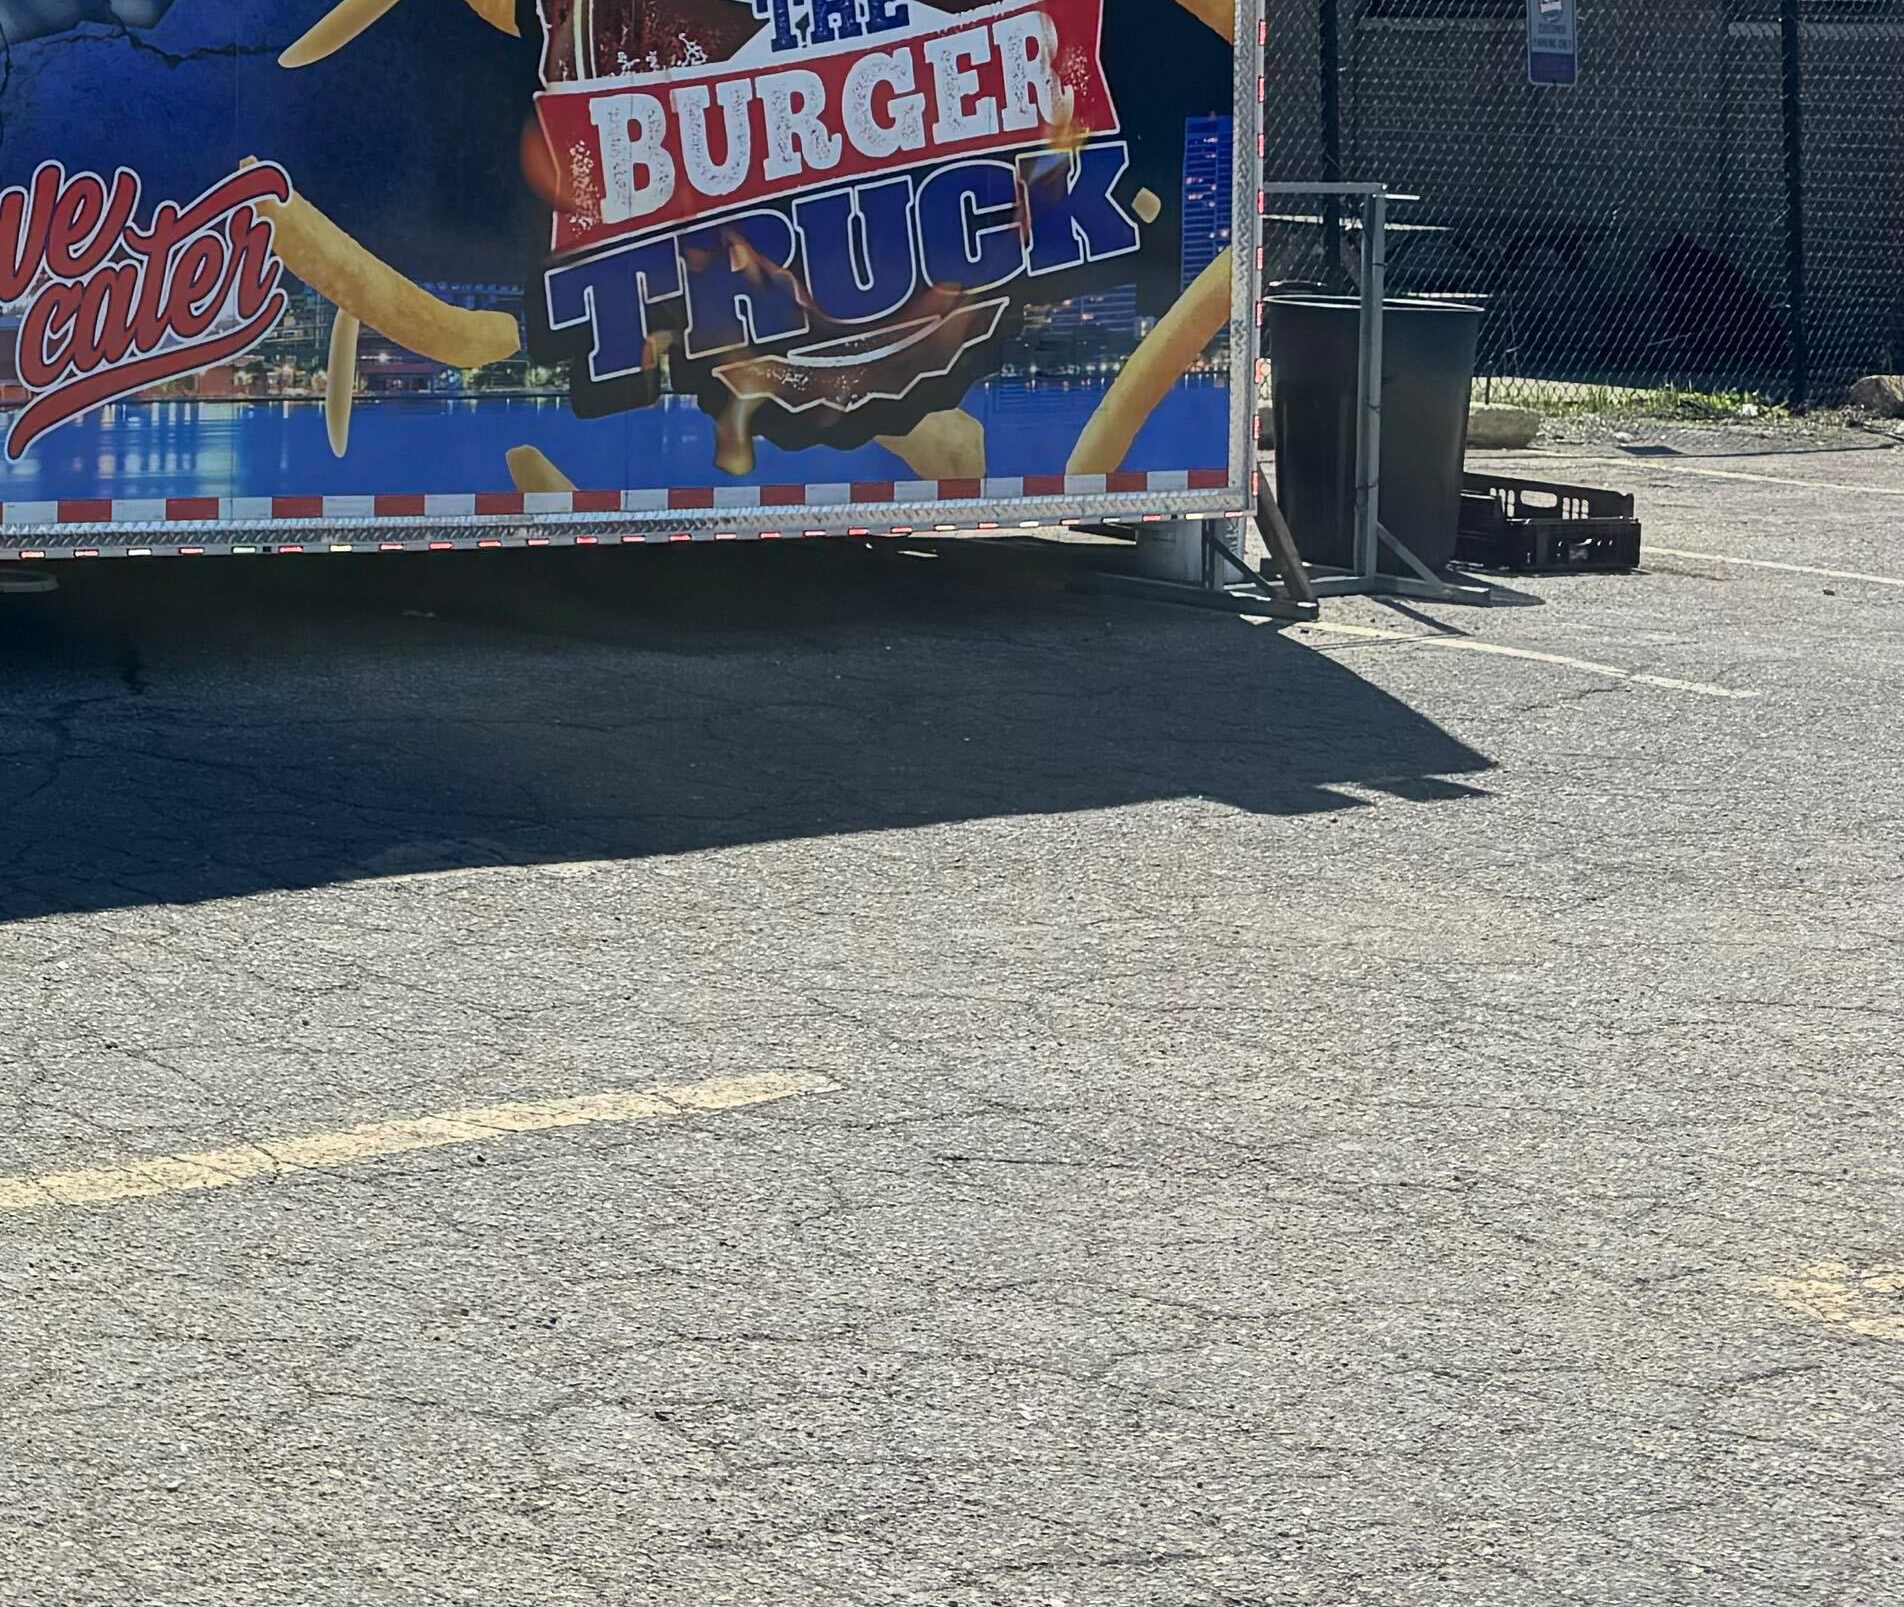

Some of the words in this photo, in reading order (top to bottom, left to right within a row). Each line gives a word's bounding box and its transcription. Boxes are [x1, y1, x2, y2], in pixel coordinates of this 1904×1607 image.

[589, 9, 1076, 227] BURGER
[15, 159, 293, 394] cater
[545, 141, 1141, 386] TRUCK
